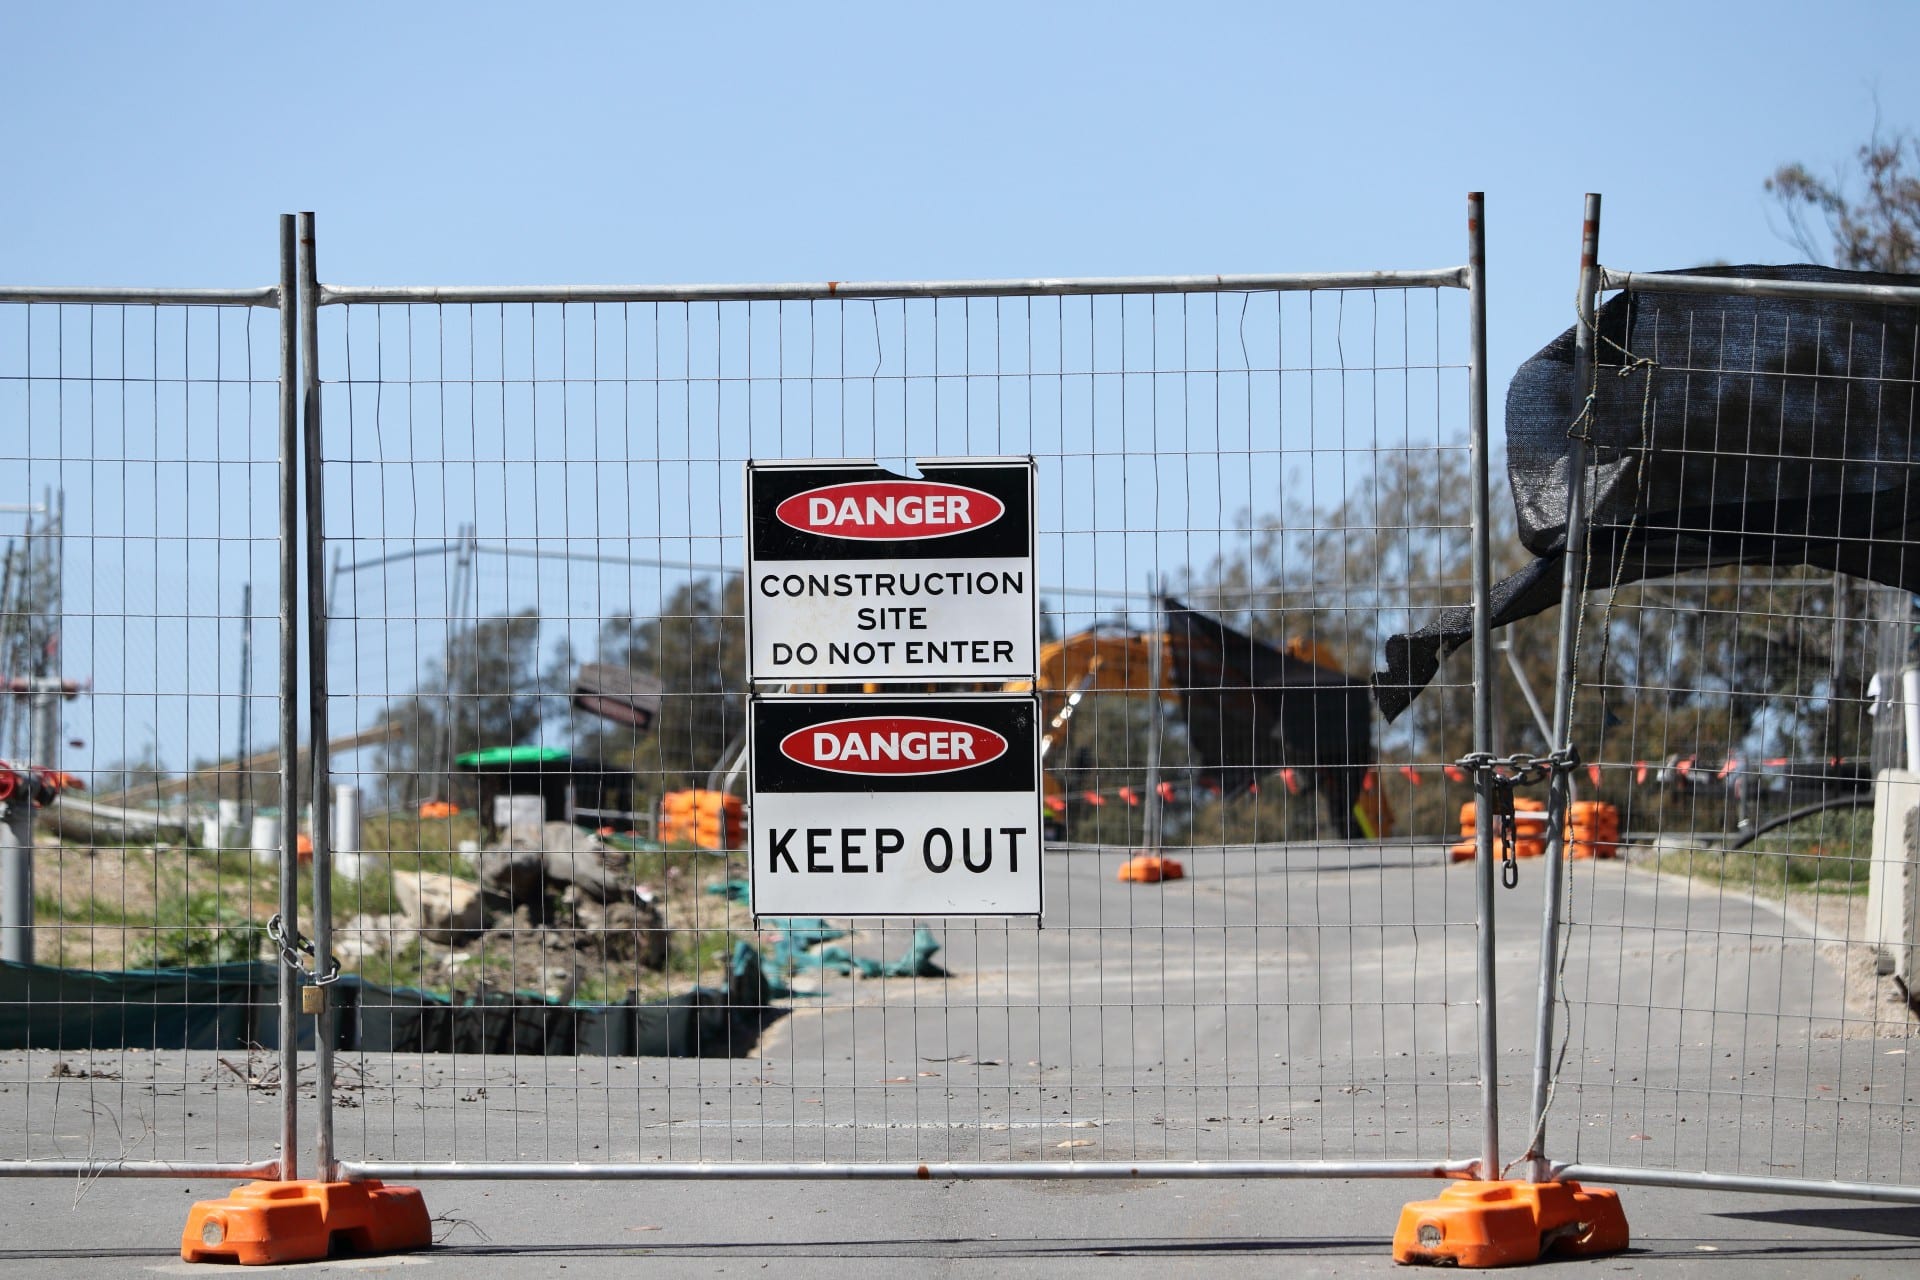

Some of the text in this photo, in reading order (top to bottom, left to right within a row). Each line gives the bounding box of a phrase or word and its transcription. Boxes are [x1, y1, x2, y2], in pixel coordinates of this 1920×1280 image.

[808, 495, 972, 526] DANGER
[760, 571, 1024, 598] CONSTRUCTION
[857, 607, 928, 631] SITE
[773, 640, 1014, 666] DO NOT ENTER
[813, 731, 976, 761] DANGER
[769, 827, 1027, 874] KEEP OUT
